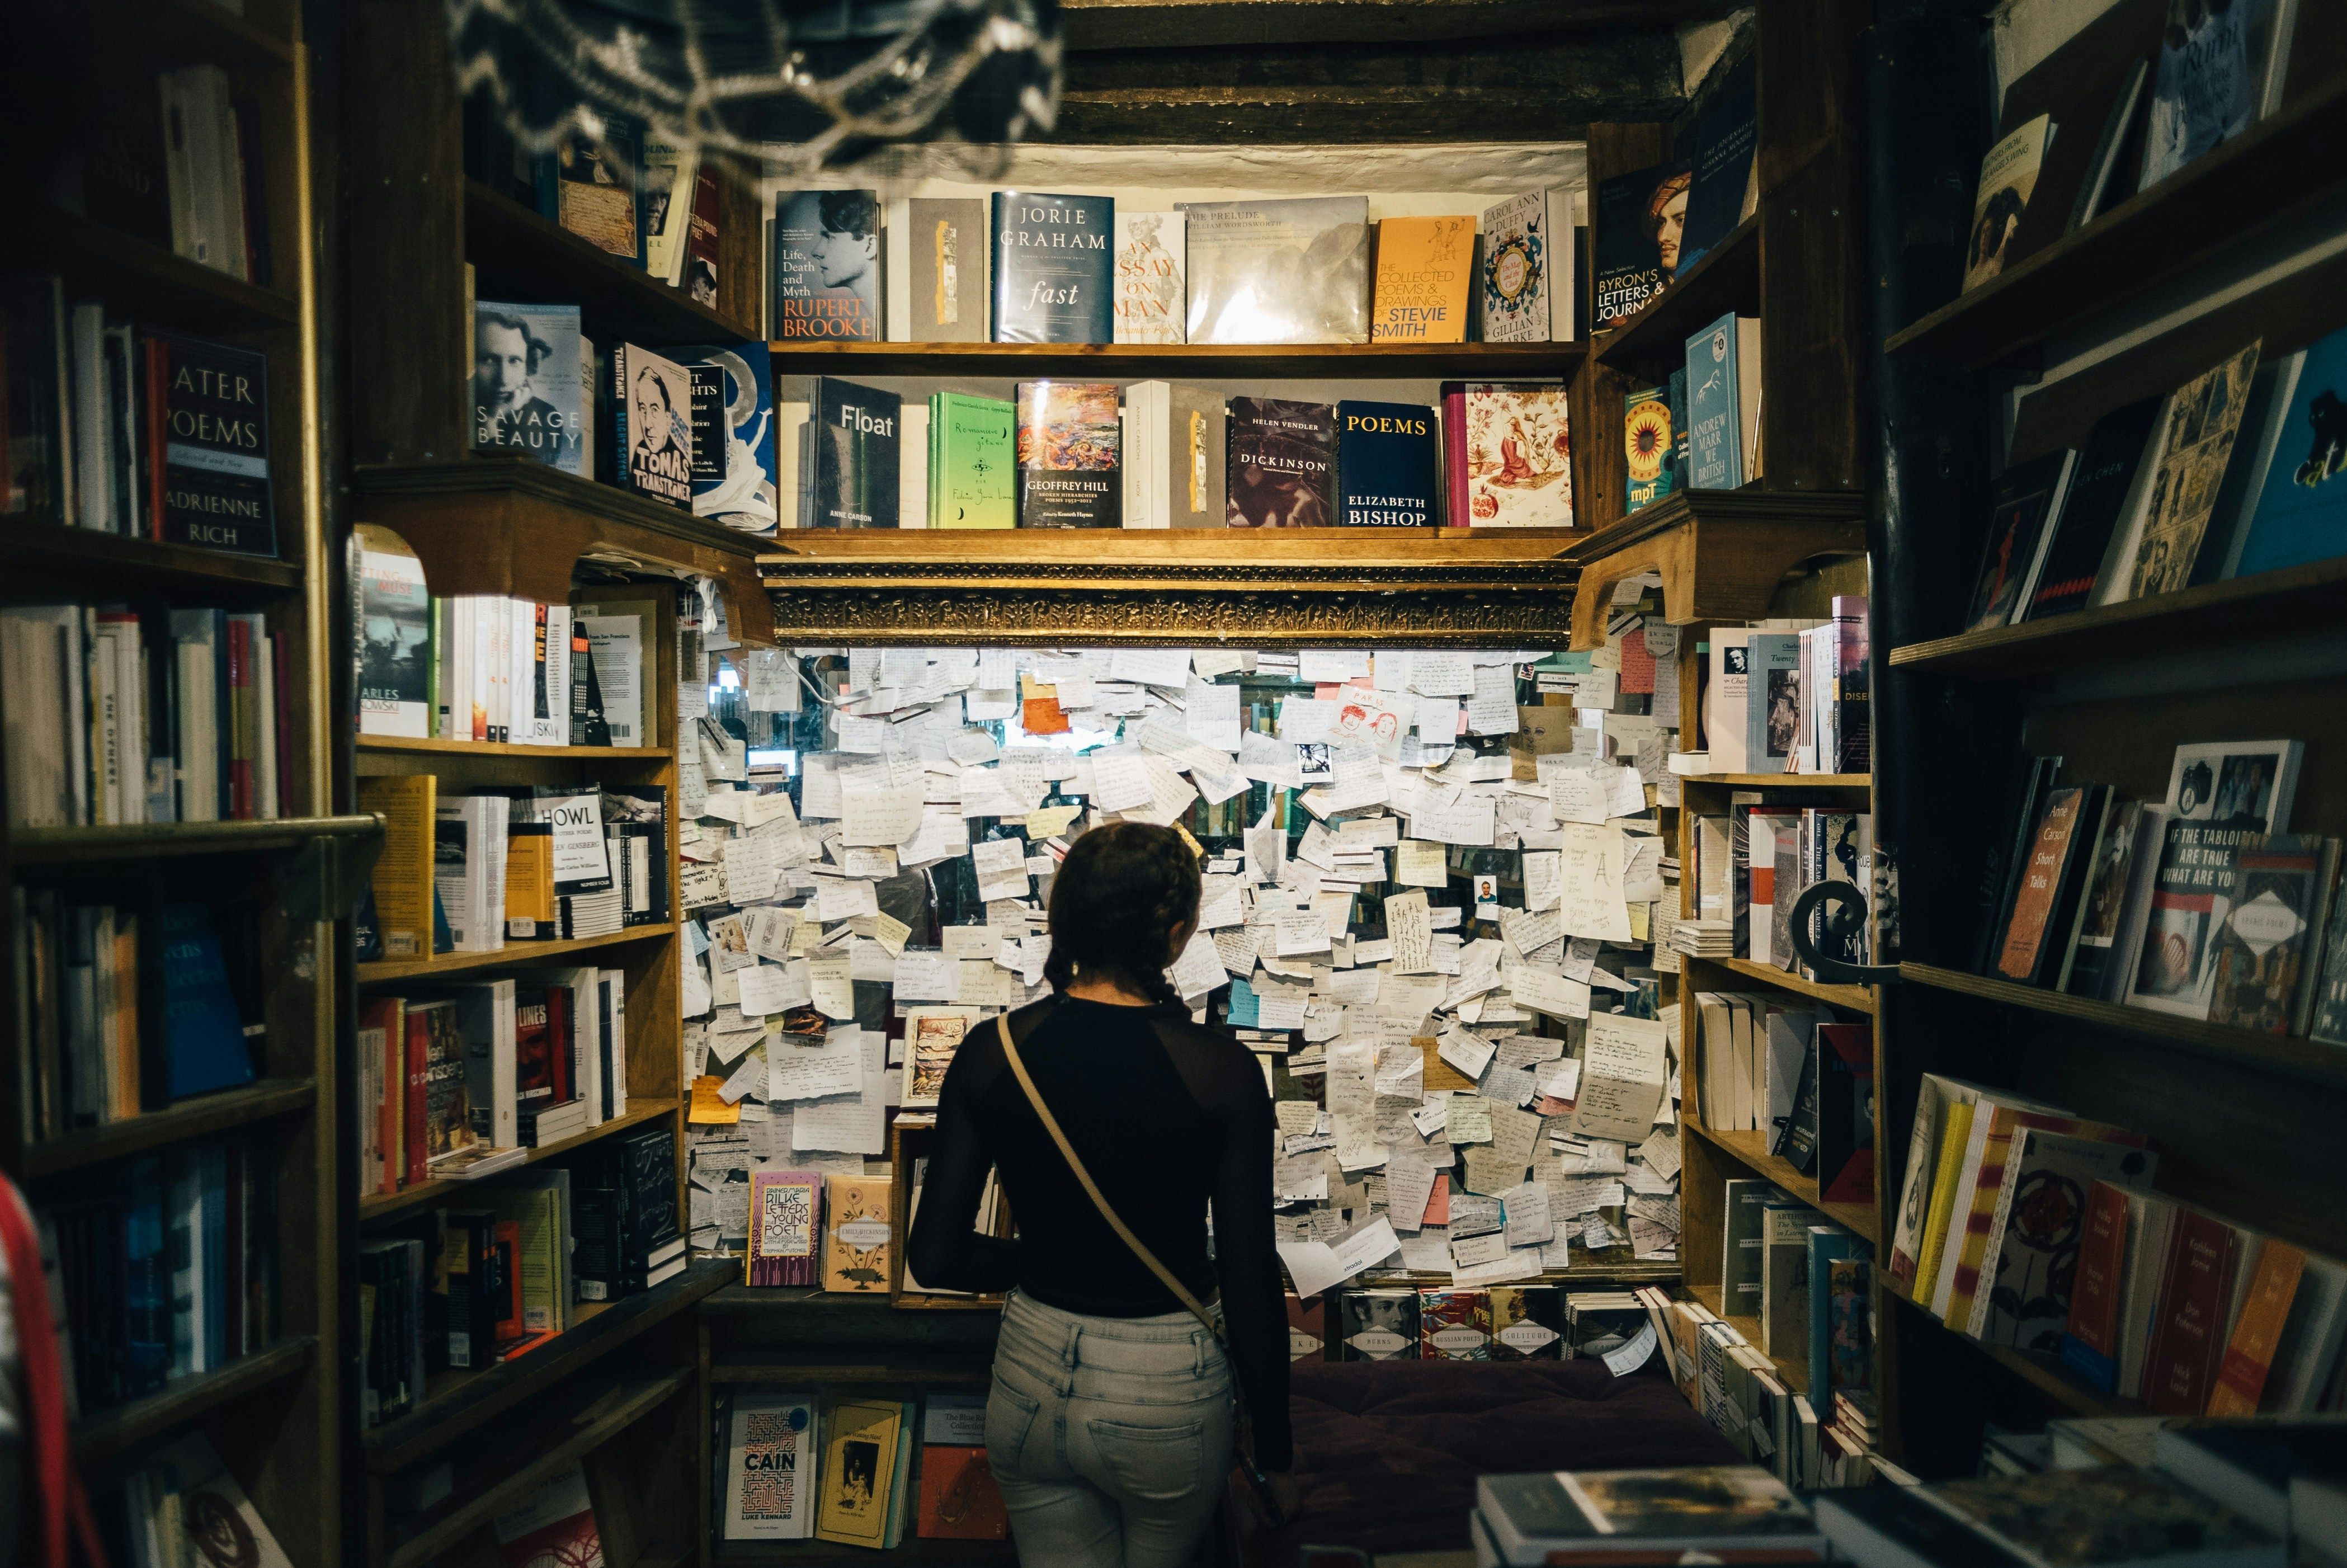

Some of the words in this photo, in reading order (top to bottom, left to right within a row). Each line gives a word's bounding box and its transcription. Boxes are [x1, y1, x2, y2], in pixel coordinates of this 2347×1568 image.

[1020, 208, 1085, 224] JORIE
[1210, 211, 1260, 220] PRELUDE
[1484, 203, 1513, 224] CAROL
[1517, 192, 1539, 210] ANN
[1496, 211, 1526, 233] DUFFY
[1001, 230, 1106, 249] GRAHAM
[783, 249, 806, 261] Life,
[1129, 242, 1152, 254] AN
[783, 261, 815, 272] Death
[783, 274, 803, 284] and
[1378, 271, 1454, 284] COLLECTED
[1599, 269, 1658, 293] BYRON'S
[783, 286, 810, 298] Myth
[1022, 281, 1078, 310] fast
[1126, 282, 1153, 295] ON
[1377, 284, 1424, 295] POEMS
[1427, 284, 1438, 294] &
[1599, 284, 1649, 308] LETTERS
[1655, 281, 1665, 295] &
[784, 299, 864, 317] RUPERT
[1375, 295, 1446, 308] DRAWINGS
[1389, 307, 1447, 322] STEVIE
[784, 318, 871, 336] BROOKE
[1372, 323, 1426, 337] SMITH
[1493, 316, 1534, 338] GILLIAN
[477, 406, 579, 429] SAVAGE
[842, 404, 893, 438] Float
[1252, 418, 1279, 426] HELEN
[1281, 421, 1319, 431] VENDLER
[1346, 416, 1426, 435] POEMS
[1694, 411, 1727, 439] ANDREW
[167, 408, 258, 448] OEMS
[478, 427, 579, 449] BEAUTY
[1699, 431, 1722, 452] MARR
[1241, 453, 1326, 472] DICKINSON
[1705, 448, 1716, 463] WE
[636, 446, 690, 484] TOMAS
[1698, 459, 1725, 482] BRITISH
[1028, 481, 1082, 491] GEOFFREY
[1083, 482, 1109, 492] HILL
[167, 491, 262, 519] ADRIENNE
[1348, 496, 1425, 508] ELIZABETH
[830, 510, 849, 521] ANNE
[850, 511, 873, 523] CARSON
[1348, 510, 1426, 526] BISHOP
[189, 524, 238, 545] RICH
[1771, 654, 1795, 664] Twenty
[1353, 692, 1383, 706] PARIS
[542, 807, 594, 826] HOWL
[2049, 805, 2068, 817] Anne
[2044, 827, 2066, 840] Carson
[2170, 828, 2180, 844] IF
[2181, 828, 2199, 844] THE
[2035, 853, 2056, 865] Short
[2179, 850, 2199, 865] ARE
[2203, 850, 2230, 867] TRUE
[2030, 875, 2047, 889] Talks
[2162, 868, 2192, 884] WHAT
[2192, 870, 2213, 886] ARE
[766, 1193, 800, 1204] RILKE
[766, 1203, 809, 1214] LETTERS
[772, 1214, 809, 1225] YOUNG
[765, 1225, 799, 1236] POET
[2188, 1238, 2217, 1259] Kathleen
[1506, 1331, 1548, 1340] SOLITUDE
[744, 1453, 795, 1471] CAIN
